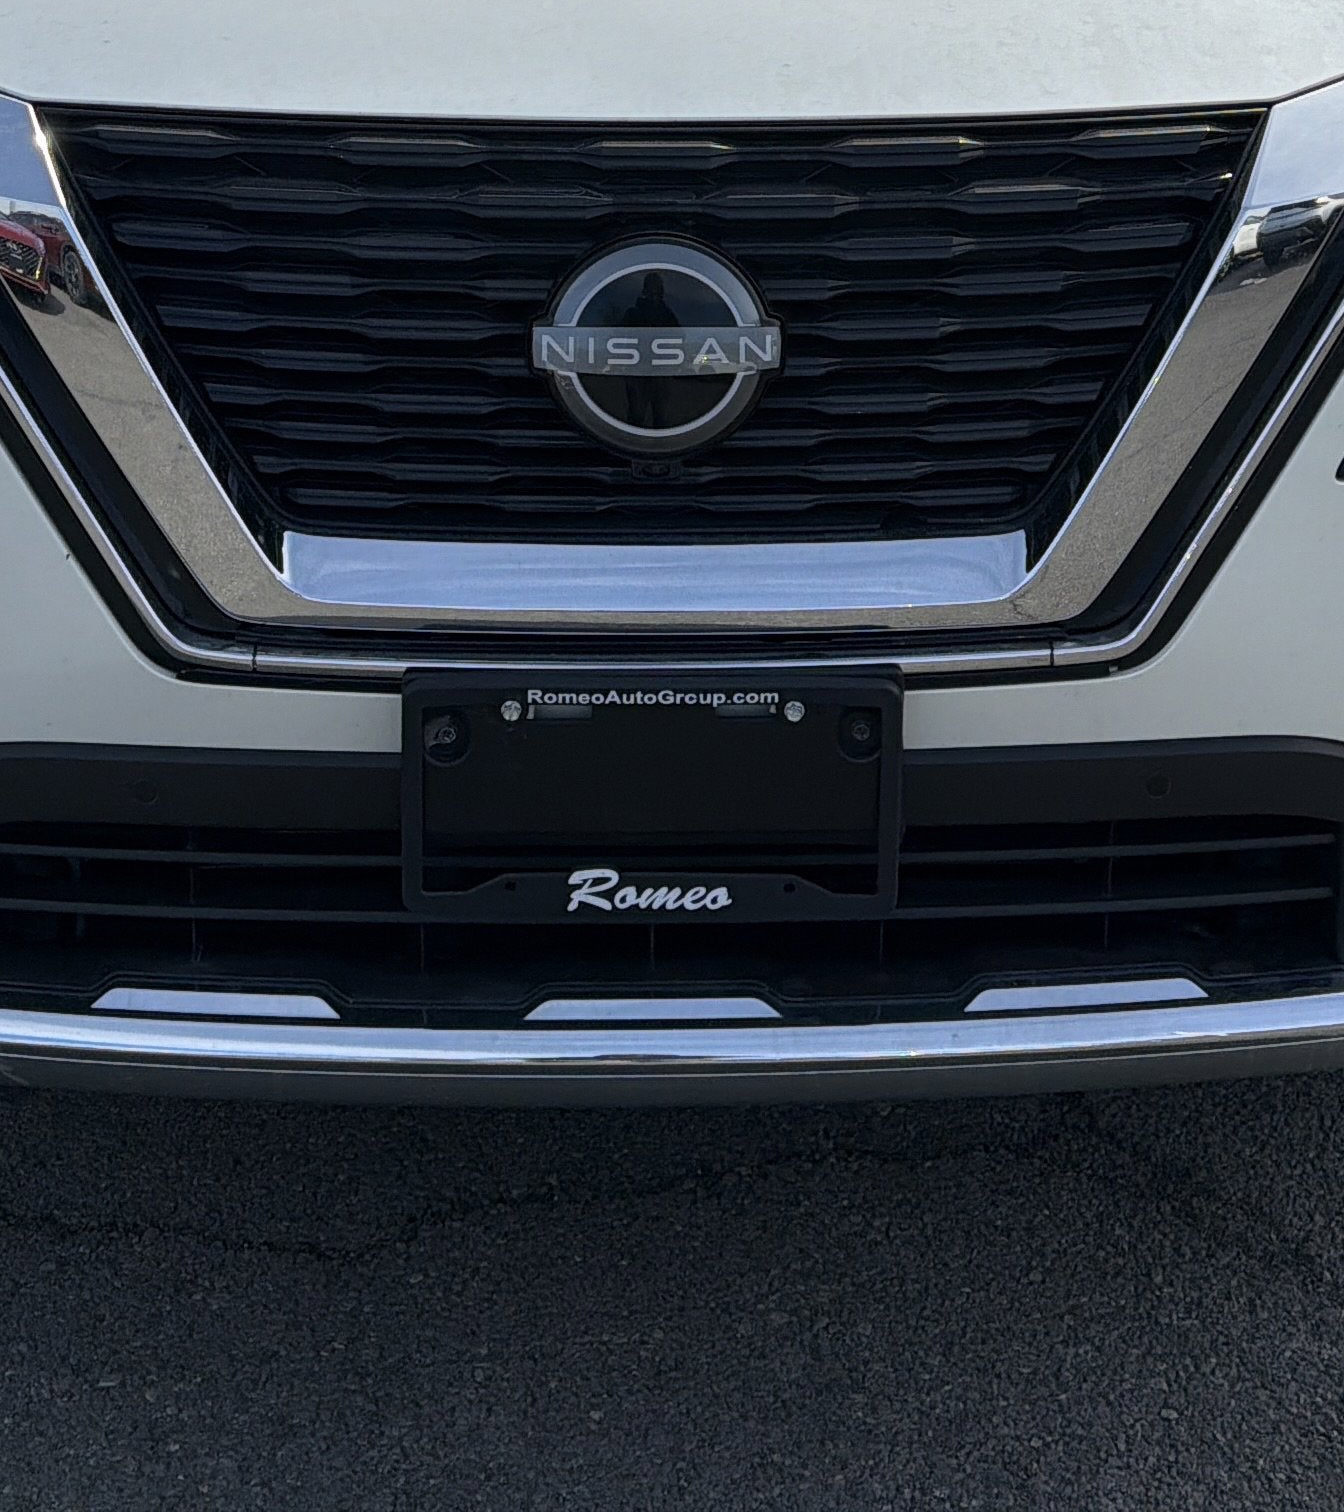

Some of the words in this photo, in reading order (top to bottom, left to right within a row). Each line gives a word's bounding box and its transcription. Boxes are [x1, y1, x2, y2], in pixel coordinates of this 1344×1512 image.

[540, 334, 772, 366] NISSAN
[526, 689, 779, 708] RomeoAutoGroup.com
[566, 868, 733, 913] Romeo
